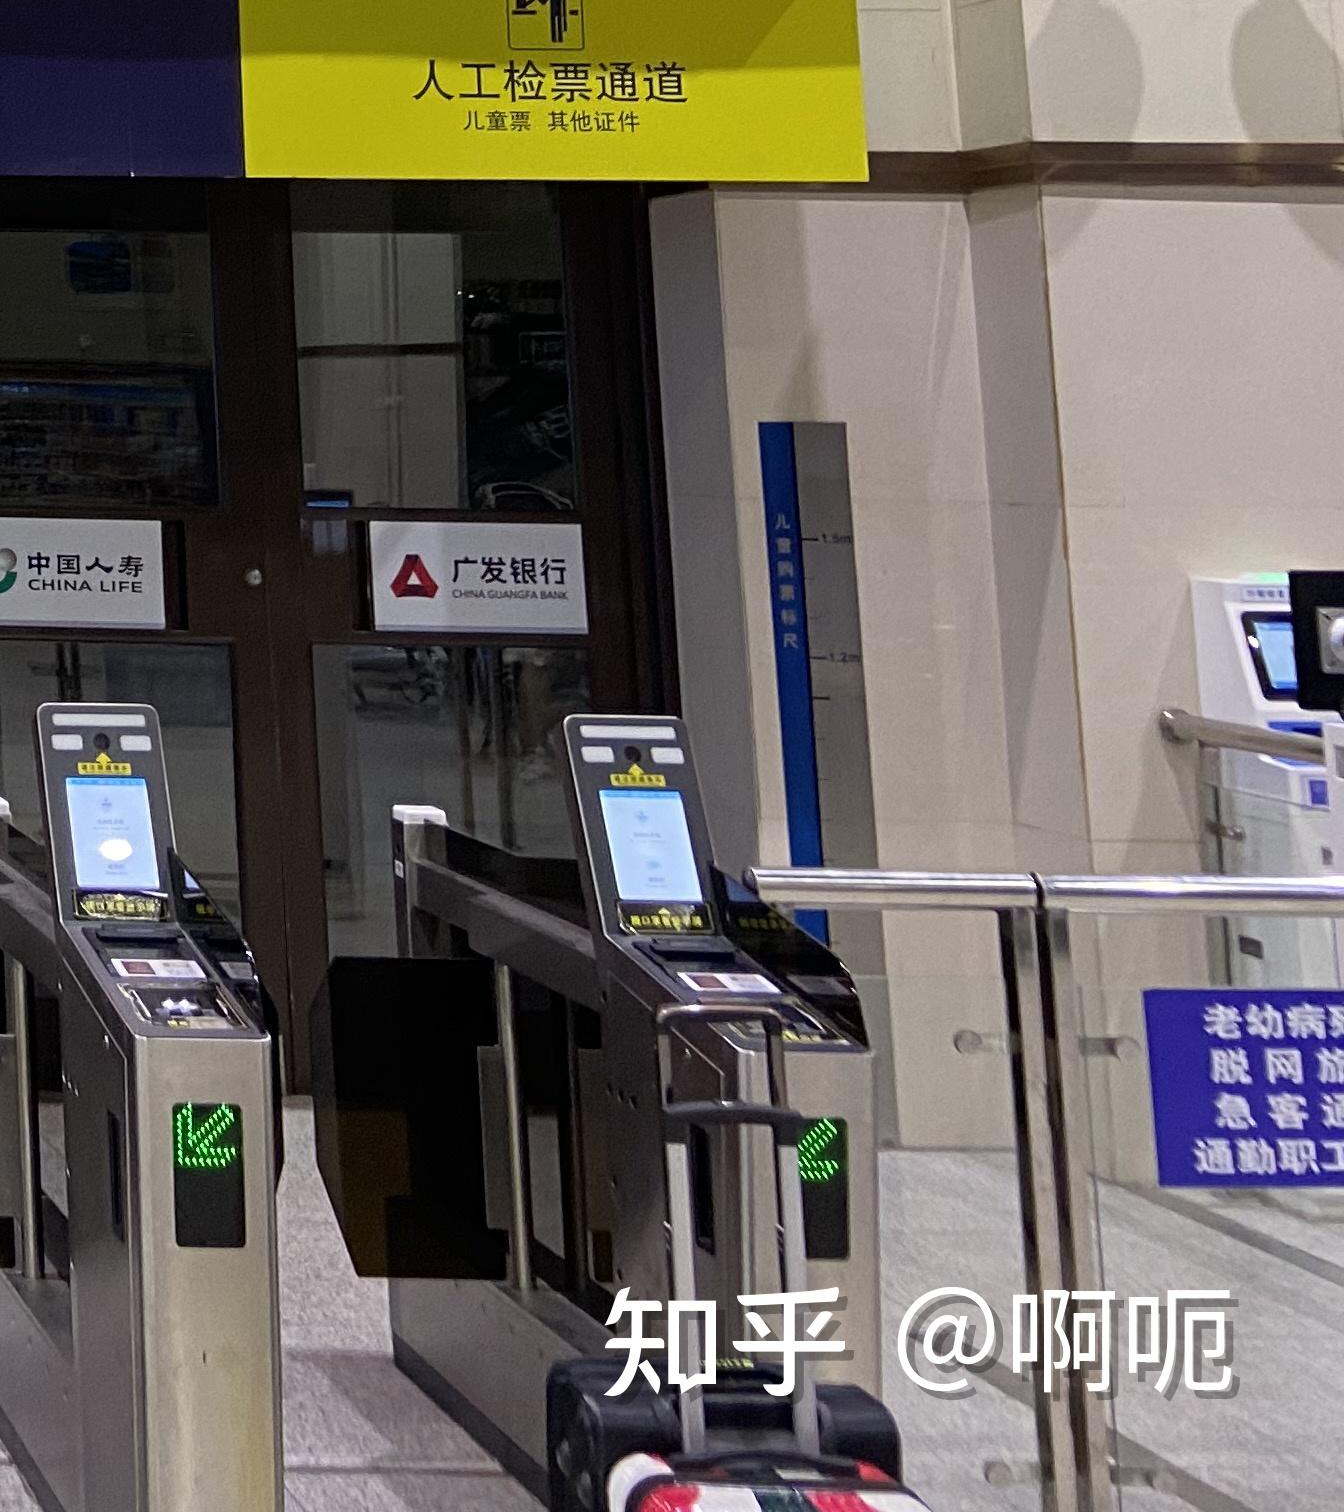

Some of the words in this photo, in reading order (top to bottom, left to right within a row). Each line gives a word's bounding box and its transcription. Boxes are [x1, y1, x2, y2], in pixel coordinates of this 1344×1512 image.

[412, 59, 689, 104] 人工检票通道
[462, 109, 532, 132] 儿童票
[546, 110, 642, 133] 其他证件
[26, 551, 145, 577] 中国人寿
[452, 555, 567, 585] 广发银行
[27, 579, 94, 593] CHINA
[99, 579, 144, 593] LIFE
